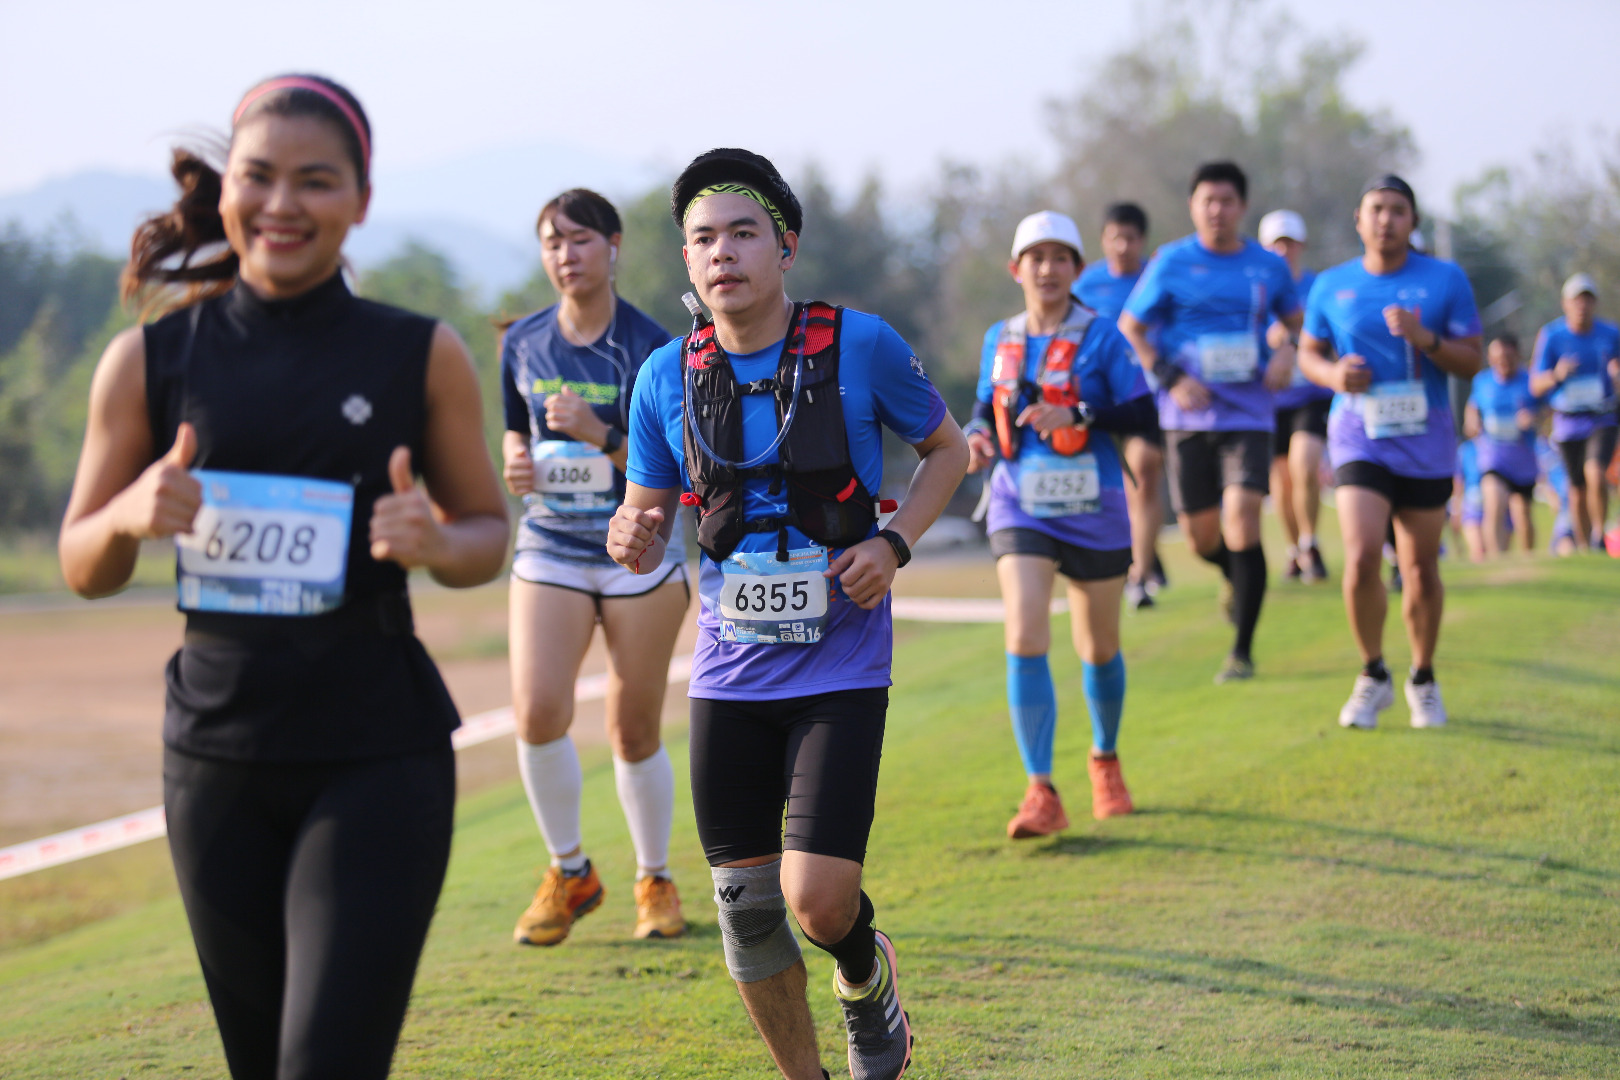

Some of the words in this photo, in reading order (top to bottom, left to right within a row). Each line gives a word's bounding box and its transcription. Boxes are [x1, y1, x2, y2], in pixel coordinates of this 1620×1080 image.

[547, 467, 592, 484] 6306
[1034, 473, 1087, 497] 6252
[205, 520, 317, 566] 6208
[735, 580, 809, 613] 6355
